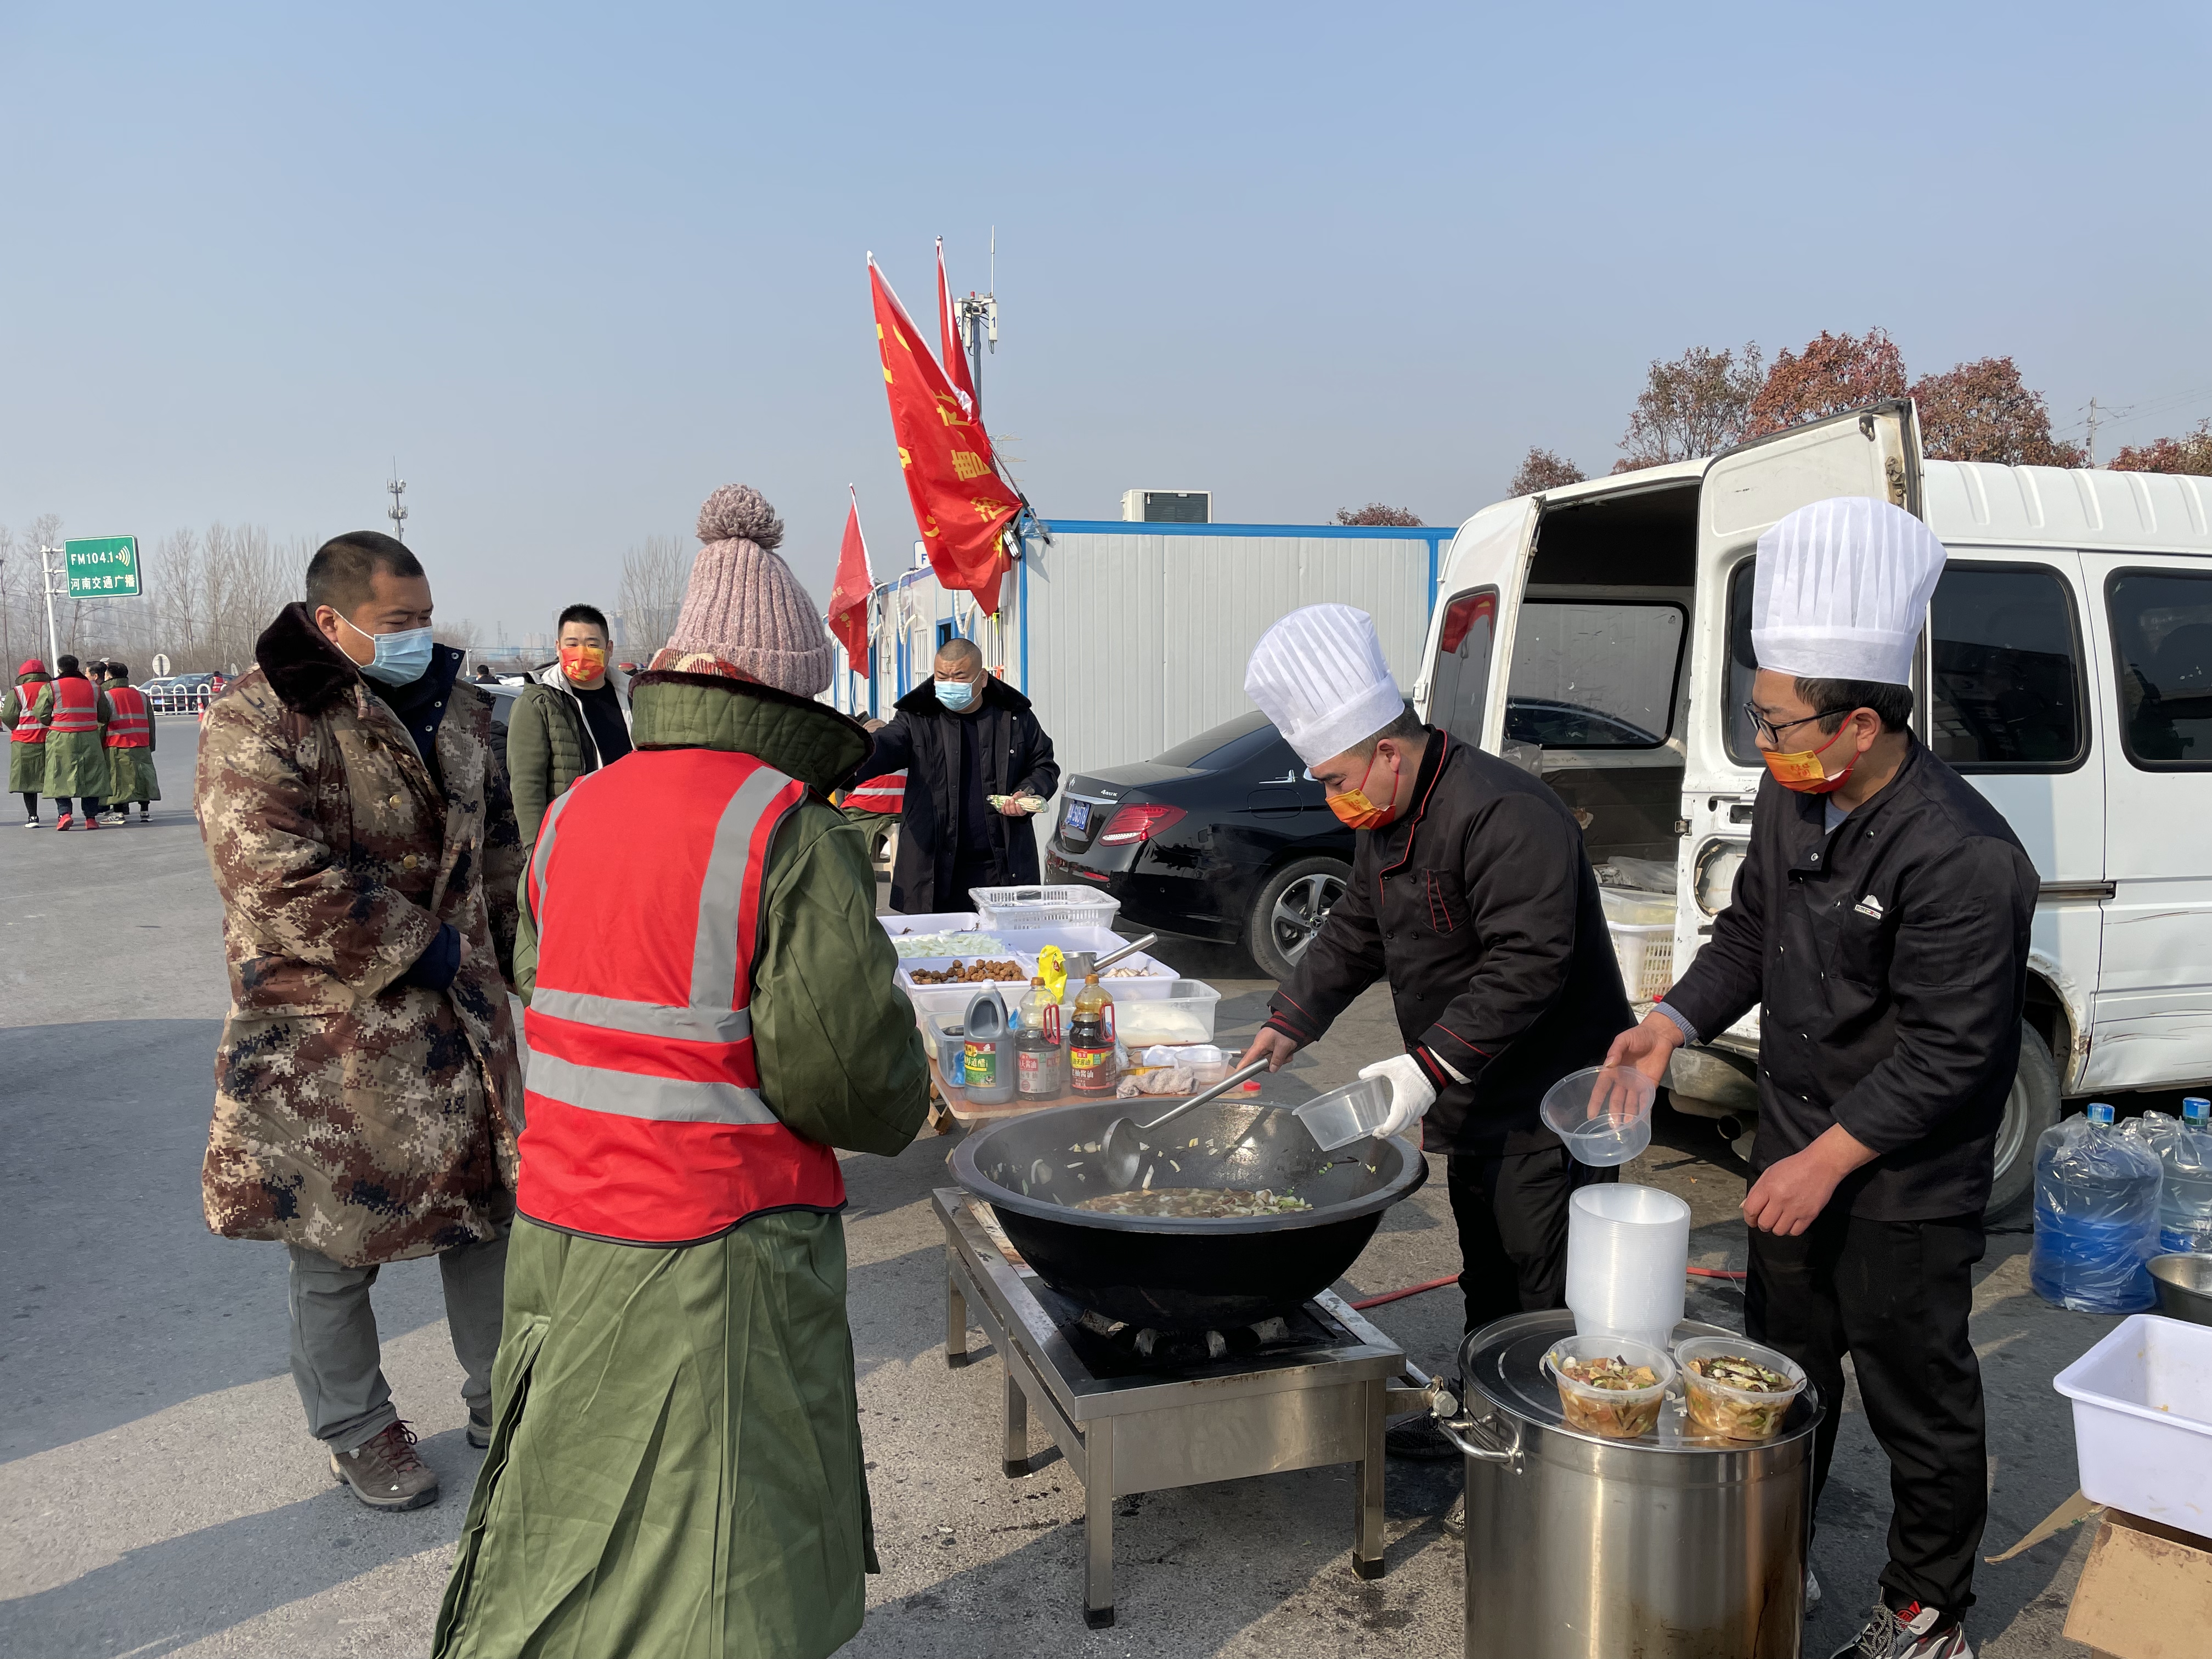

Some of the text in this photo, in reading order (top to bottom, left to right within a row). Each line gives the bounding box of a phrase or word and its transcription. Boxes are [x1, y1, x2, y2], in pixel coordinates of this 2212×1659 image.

[991, 316, 996, 328] 1
[70, 551, 114, 566] FM104.1
[70, 574, 135, 591] 河南交通广播
